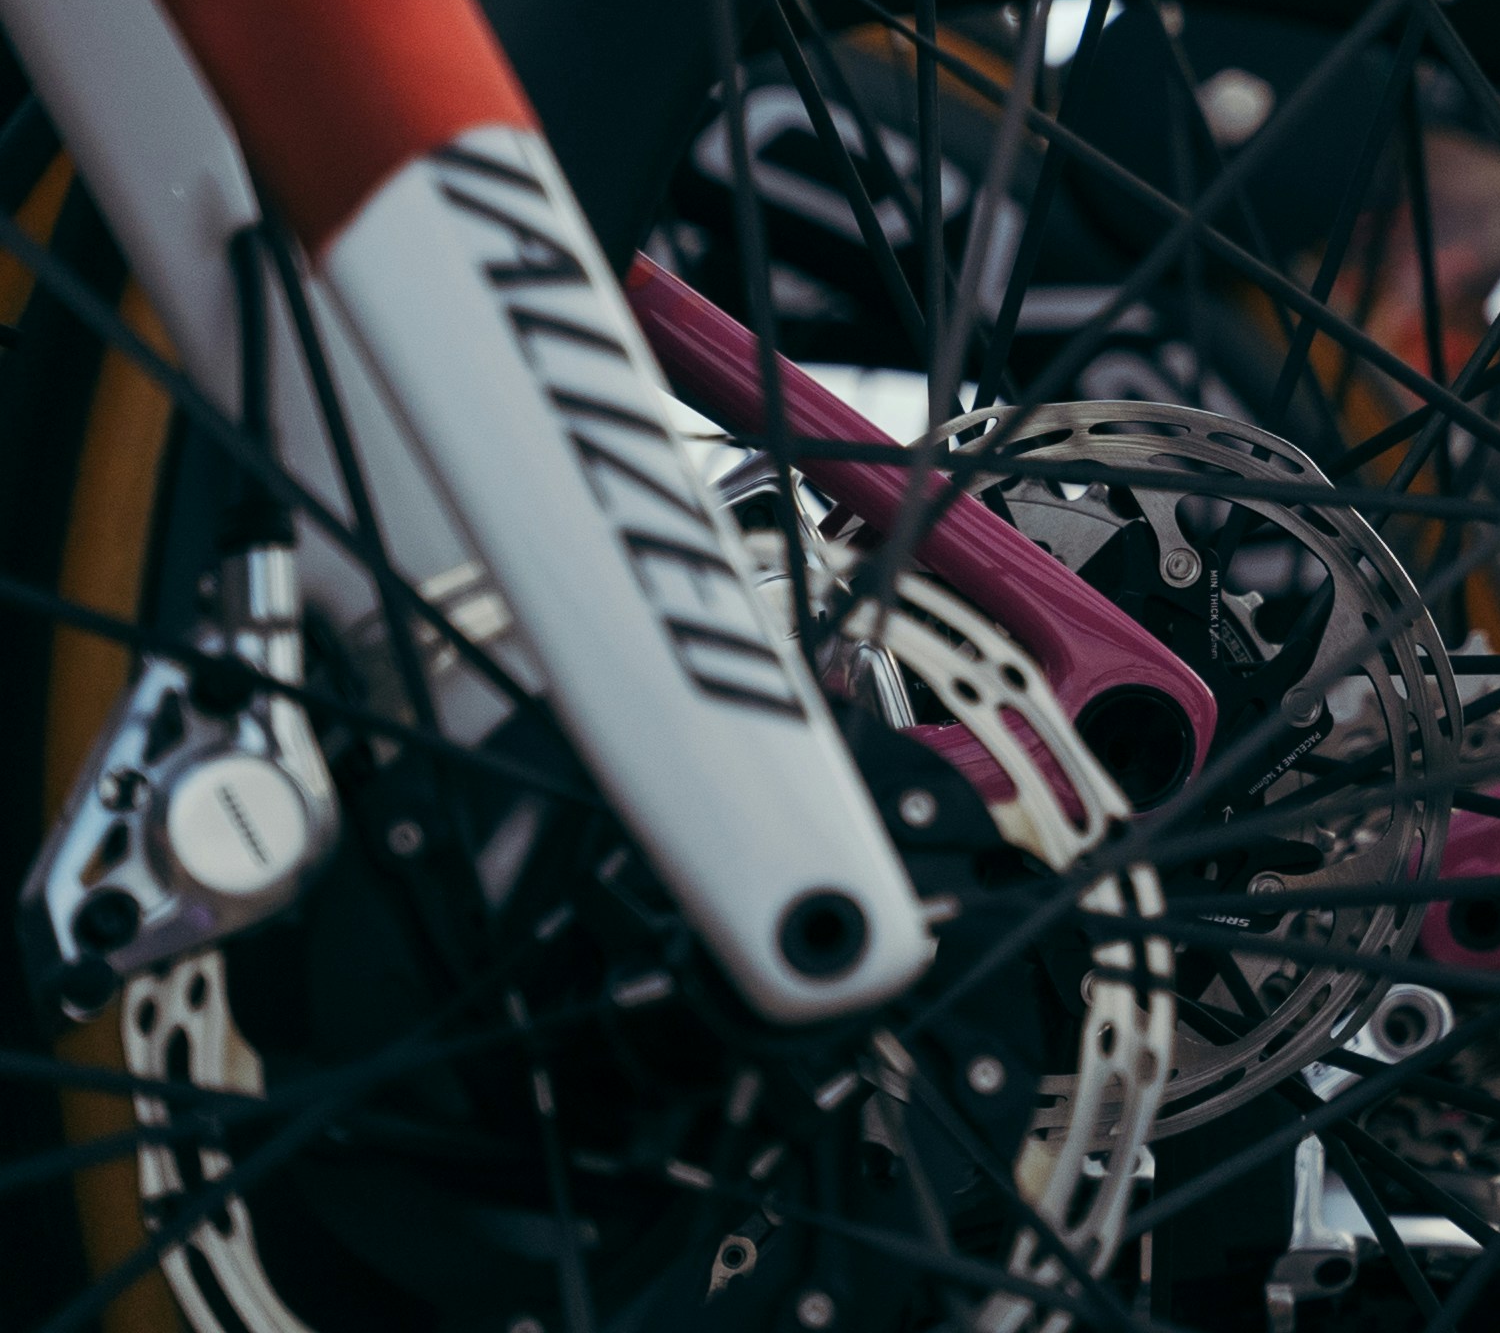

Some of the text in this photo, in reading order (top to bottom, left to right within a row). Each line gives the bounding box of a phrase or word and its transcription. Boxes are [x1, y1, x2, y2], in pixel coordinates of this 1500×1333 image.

[1209, 593, 1219, 621] THICK
[1282, 730, 1322, 767] PACELINE
[1274, 764, 1284, 773] X
